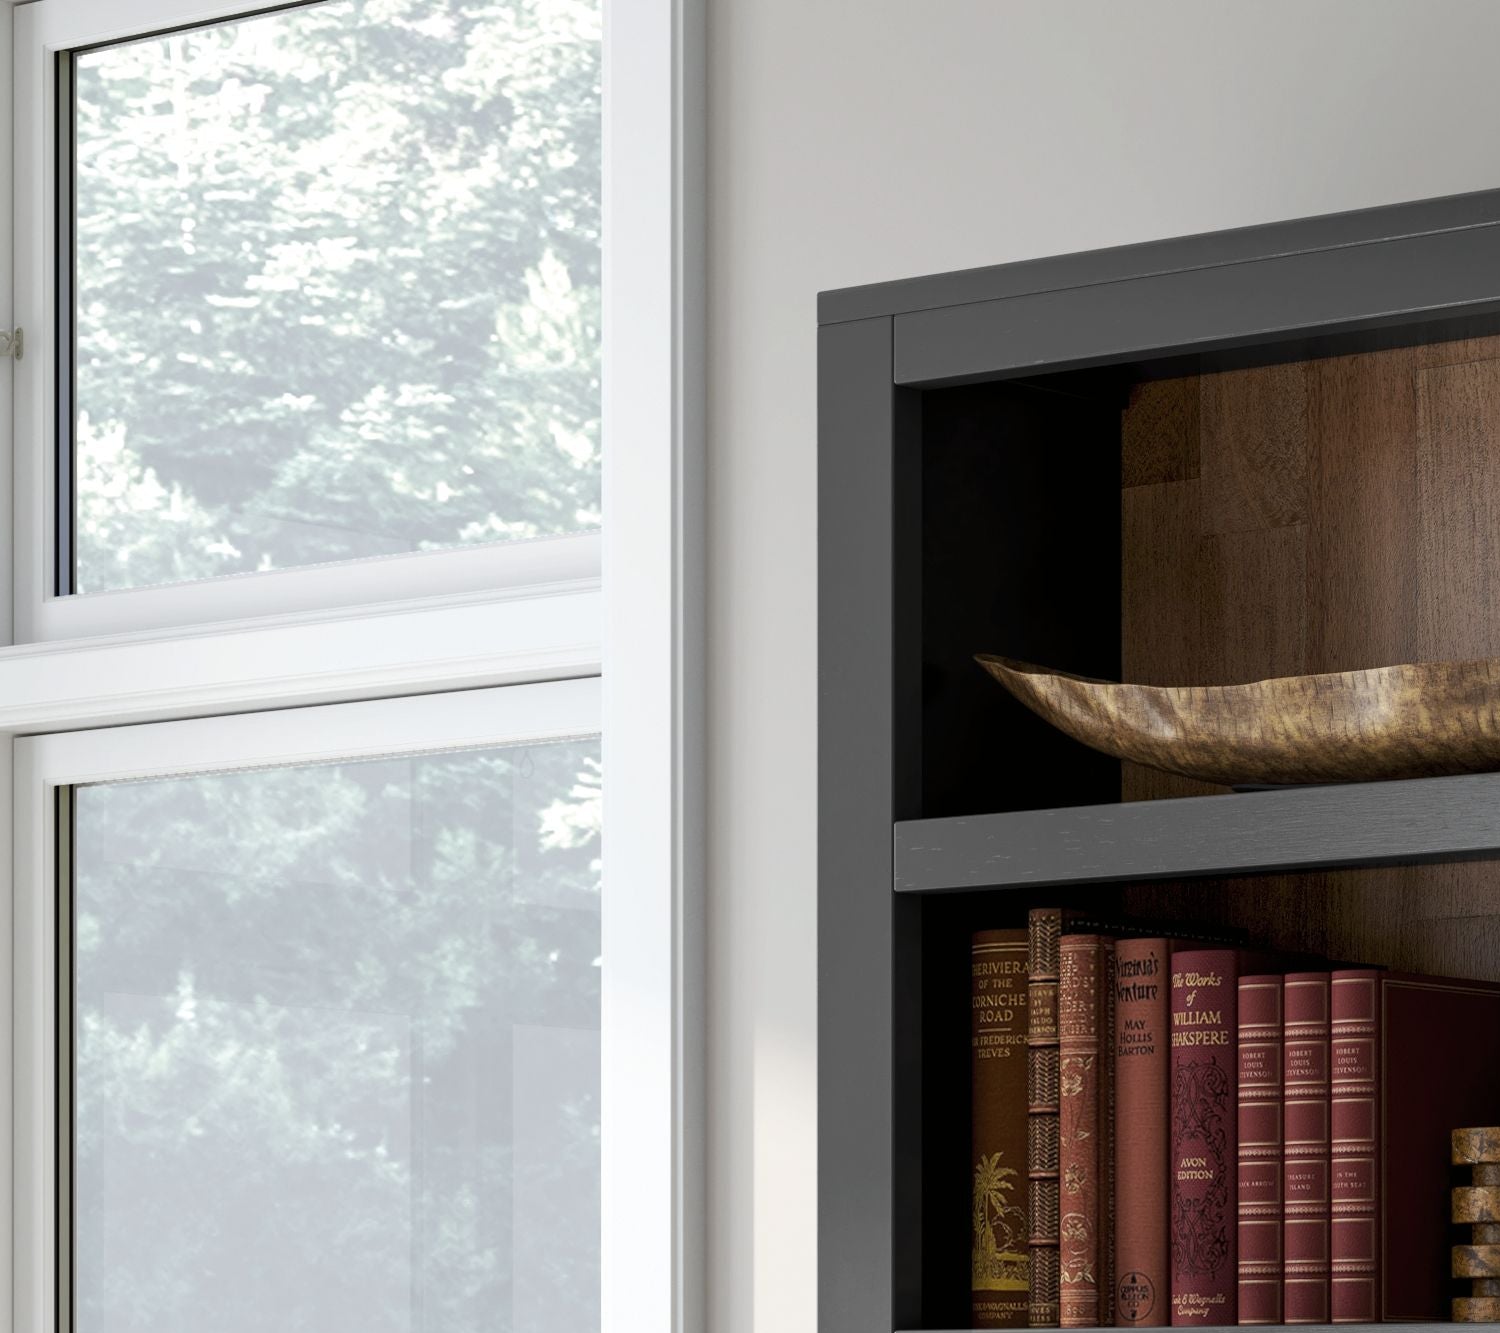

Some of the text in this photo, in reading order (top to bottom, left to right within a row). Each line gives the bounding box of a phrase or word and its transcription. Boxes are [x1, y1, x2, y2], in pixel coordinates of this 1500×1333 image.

[979, 978, 1013, 989] OF THE
[1173, 971, 1222, 988] The Works
[1116, 982, 1158, 1002] Venture
[972, 993, 1026, 1008] CORNICHE
[1186, 990, 1197, 1007] of
[980, 1010, 1013, 1023] ROAD
[1174, 1010, 1221, 1026] WILLIAM
[1125, 1020, 1145, 1030] MAY
[1121, 1032, 1152, 1044] HOLLIS
[978, 1048, 1010, 1058] TREVES
[1118, 1046, 1154, 1057] BARTON
[1180, 1157, 1207, 1168] AVON
[1178, 1170, 1214, 1180] EDITION
[1178, 1305, 1210, 1317] Company
